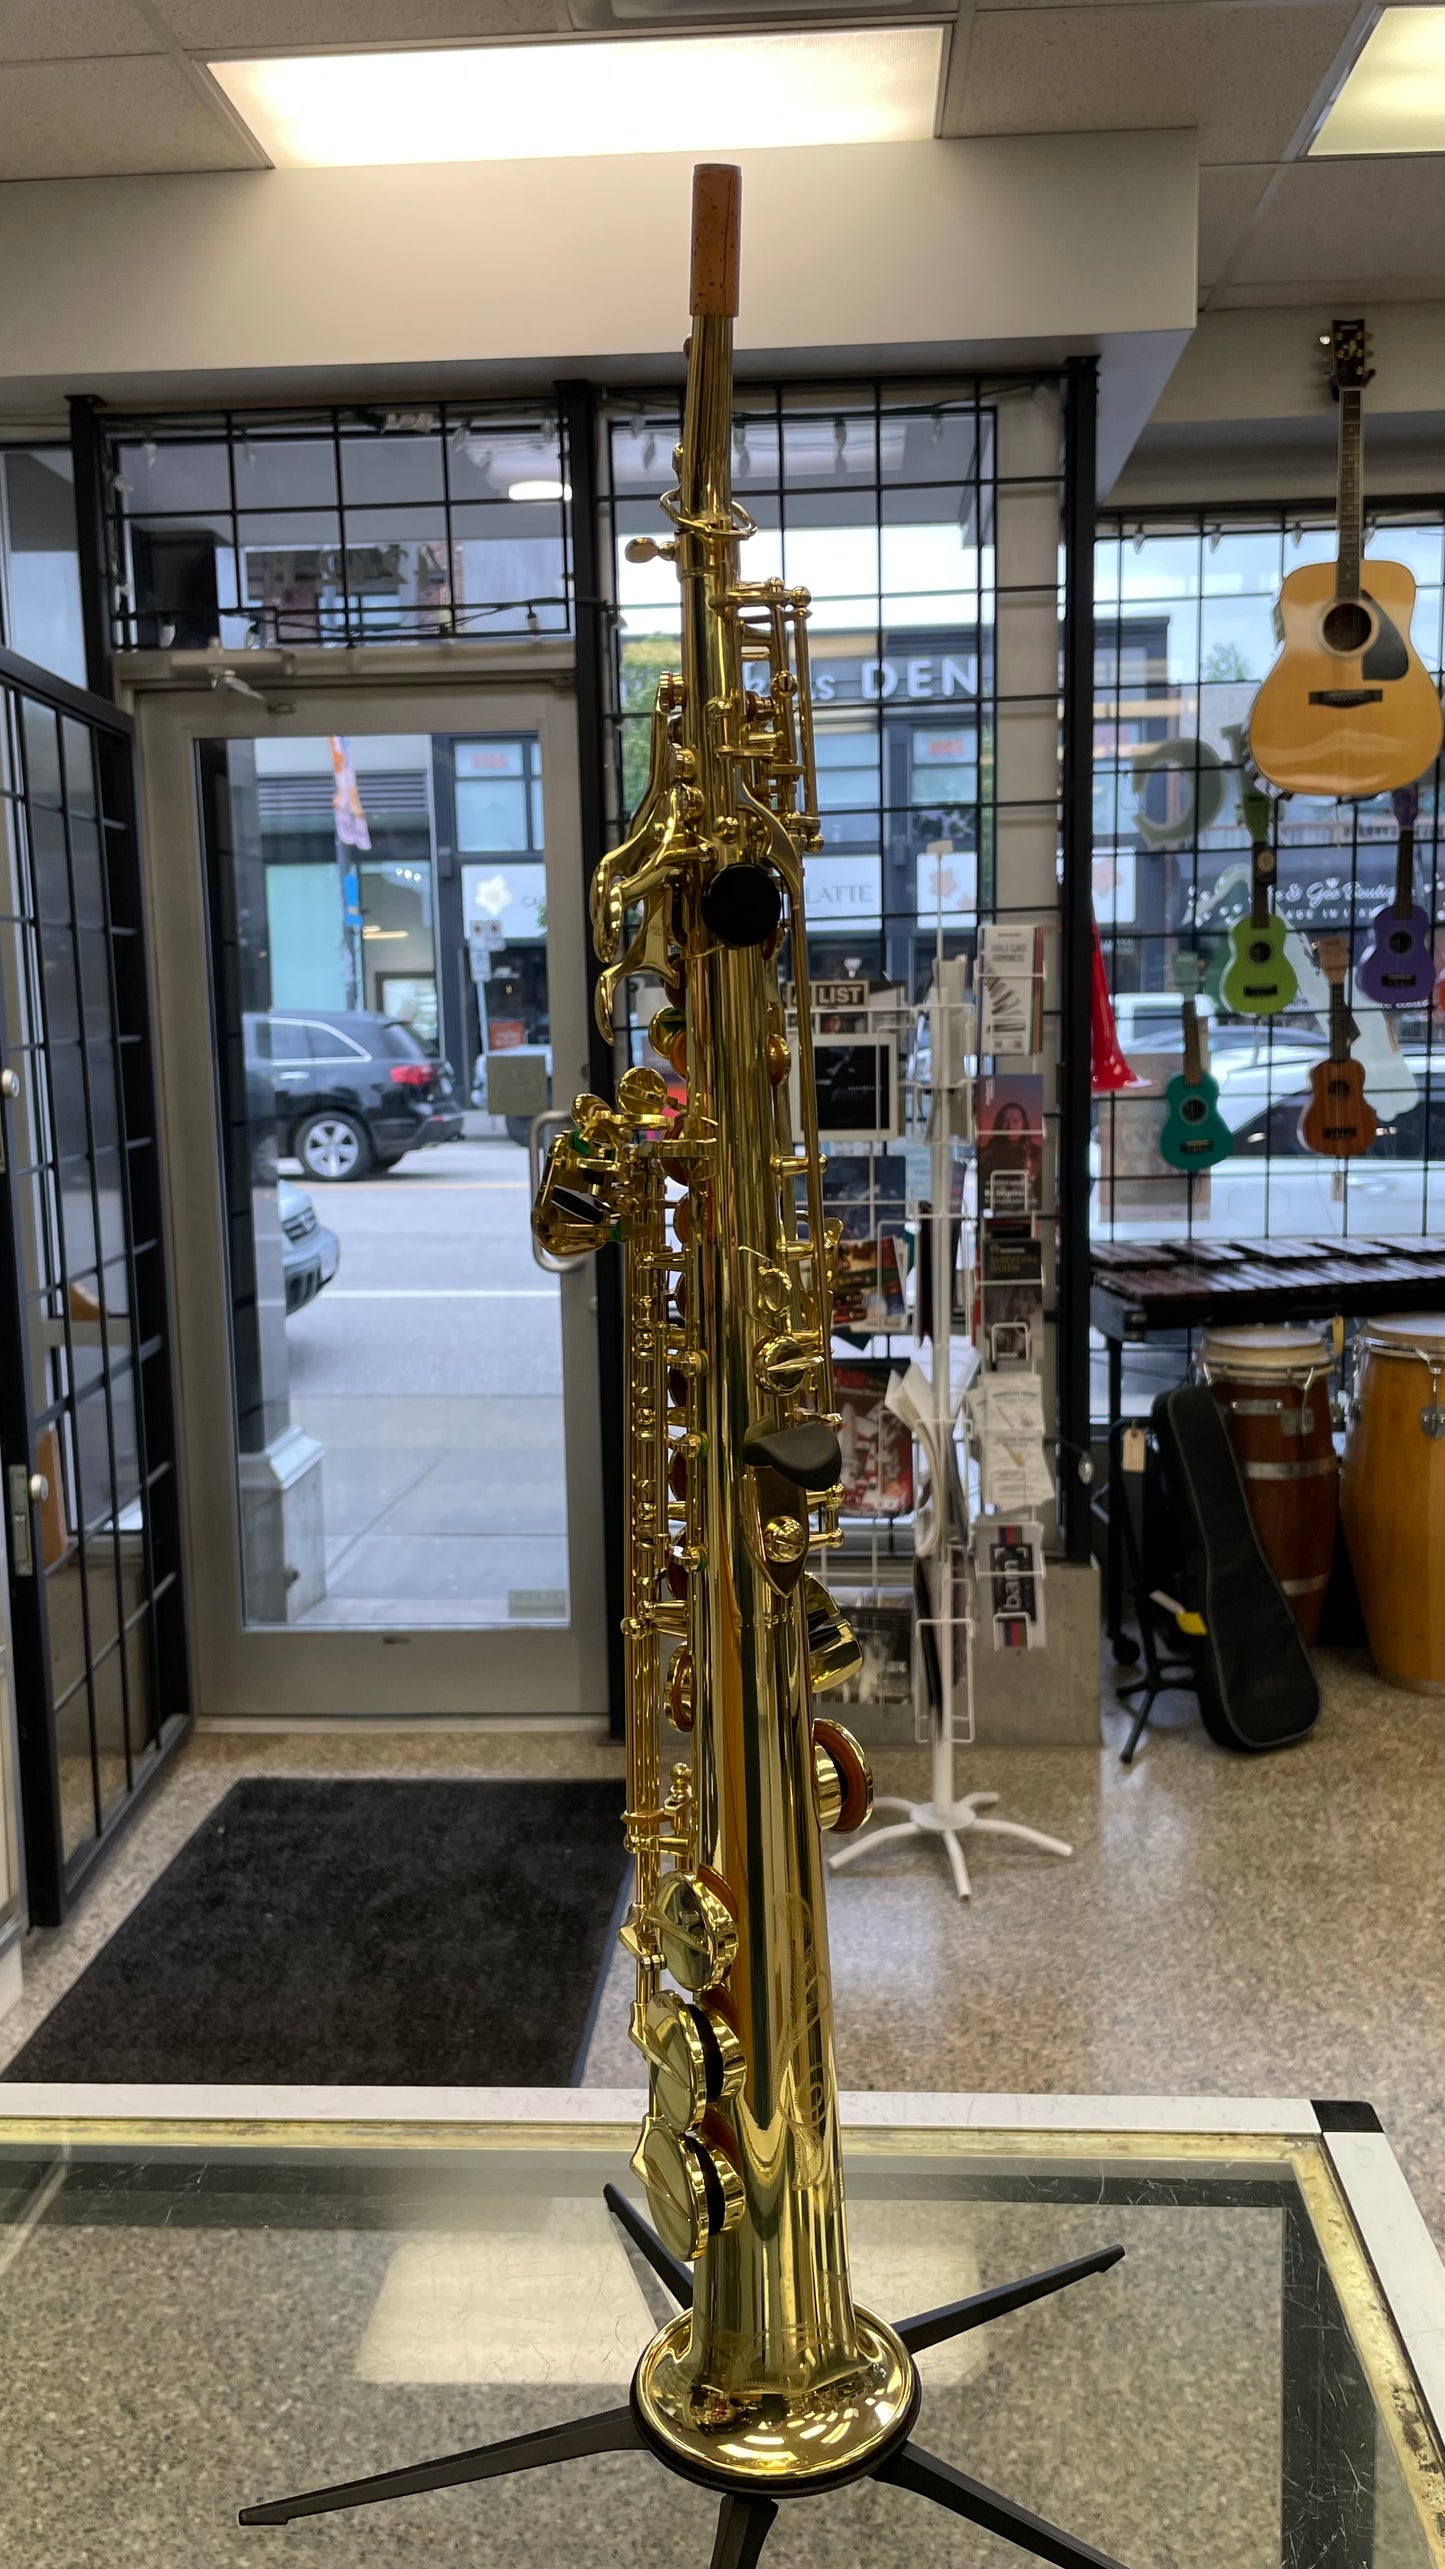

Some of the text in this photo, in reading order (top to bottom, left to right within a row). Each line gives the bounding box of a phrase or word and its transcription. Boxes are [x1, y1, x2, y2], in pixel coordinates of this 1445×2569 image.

[861, 654, 978, 699] DEN
[1286, 908, 1314, 919] ADE
[818, 986, 862, 1004] LIST
[1003, 1559, 1022, 1608] bam
